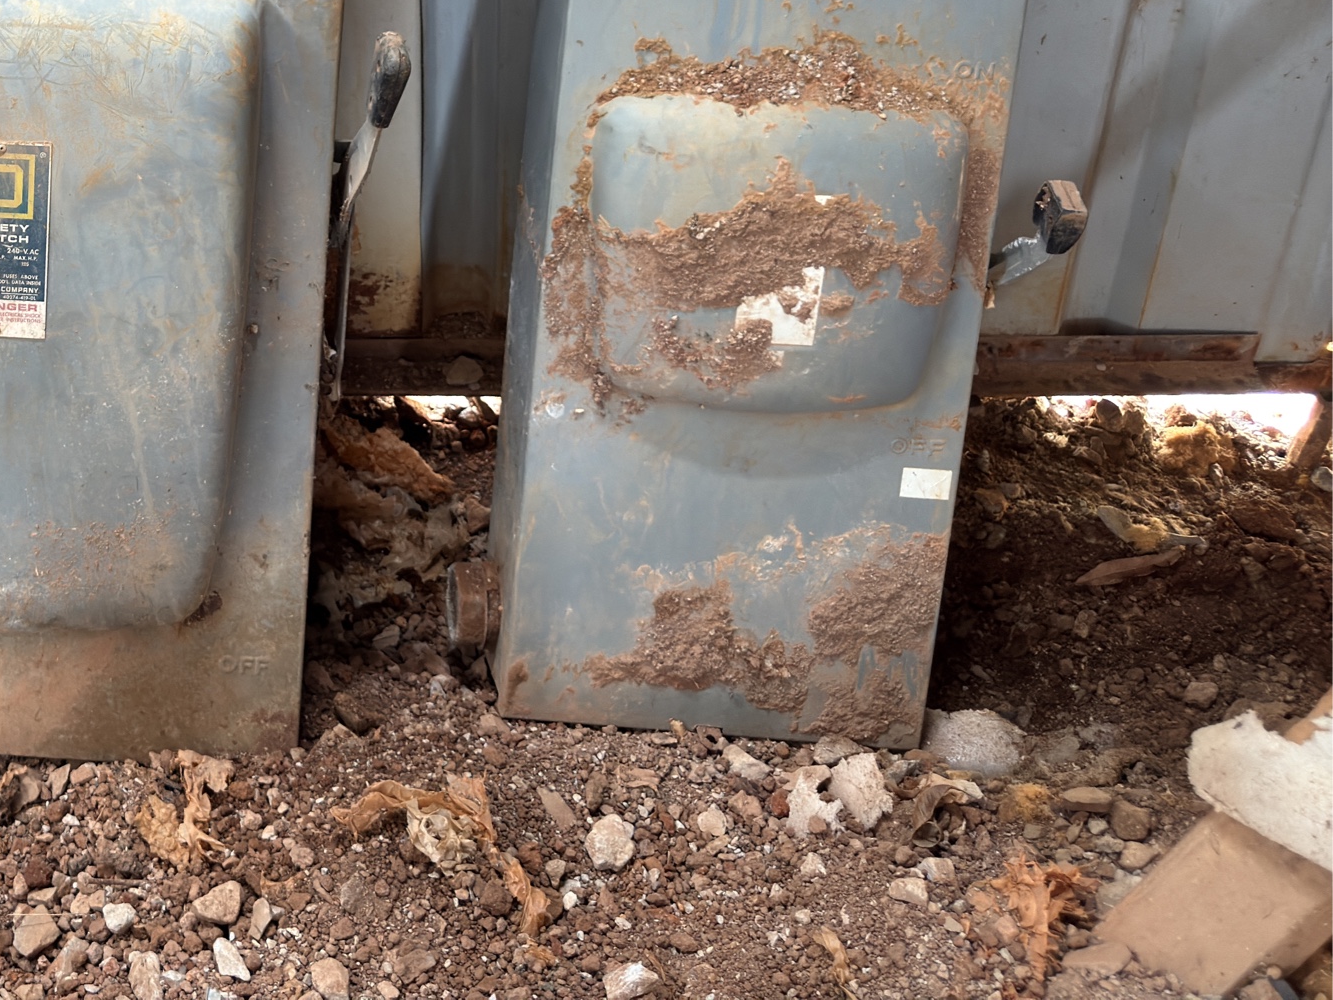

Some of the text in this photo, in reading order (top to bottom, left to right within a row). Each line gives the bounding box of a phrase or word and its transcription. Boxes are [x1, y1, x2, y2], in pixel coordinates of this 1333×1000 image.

[953, 60, 996, 81] ON
[0, 286, 40, 294] COMPANY
[891, 438, 947, 457] OFF
[219, 654, 269, 675] OFF
